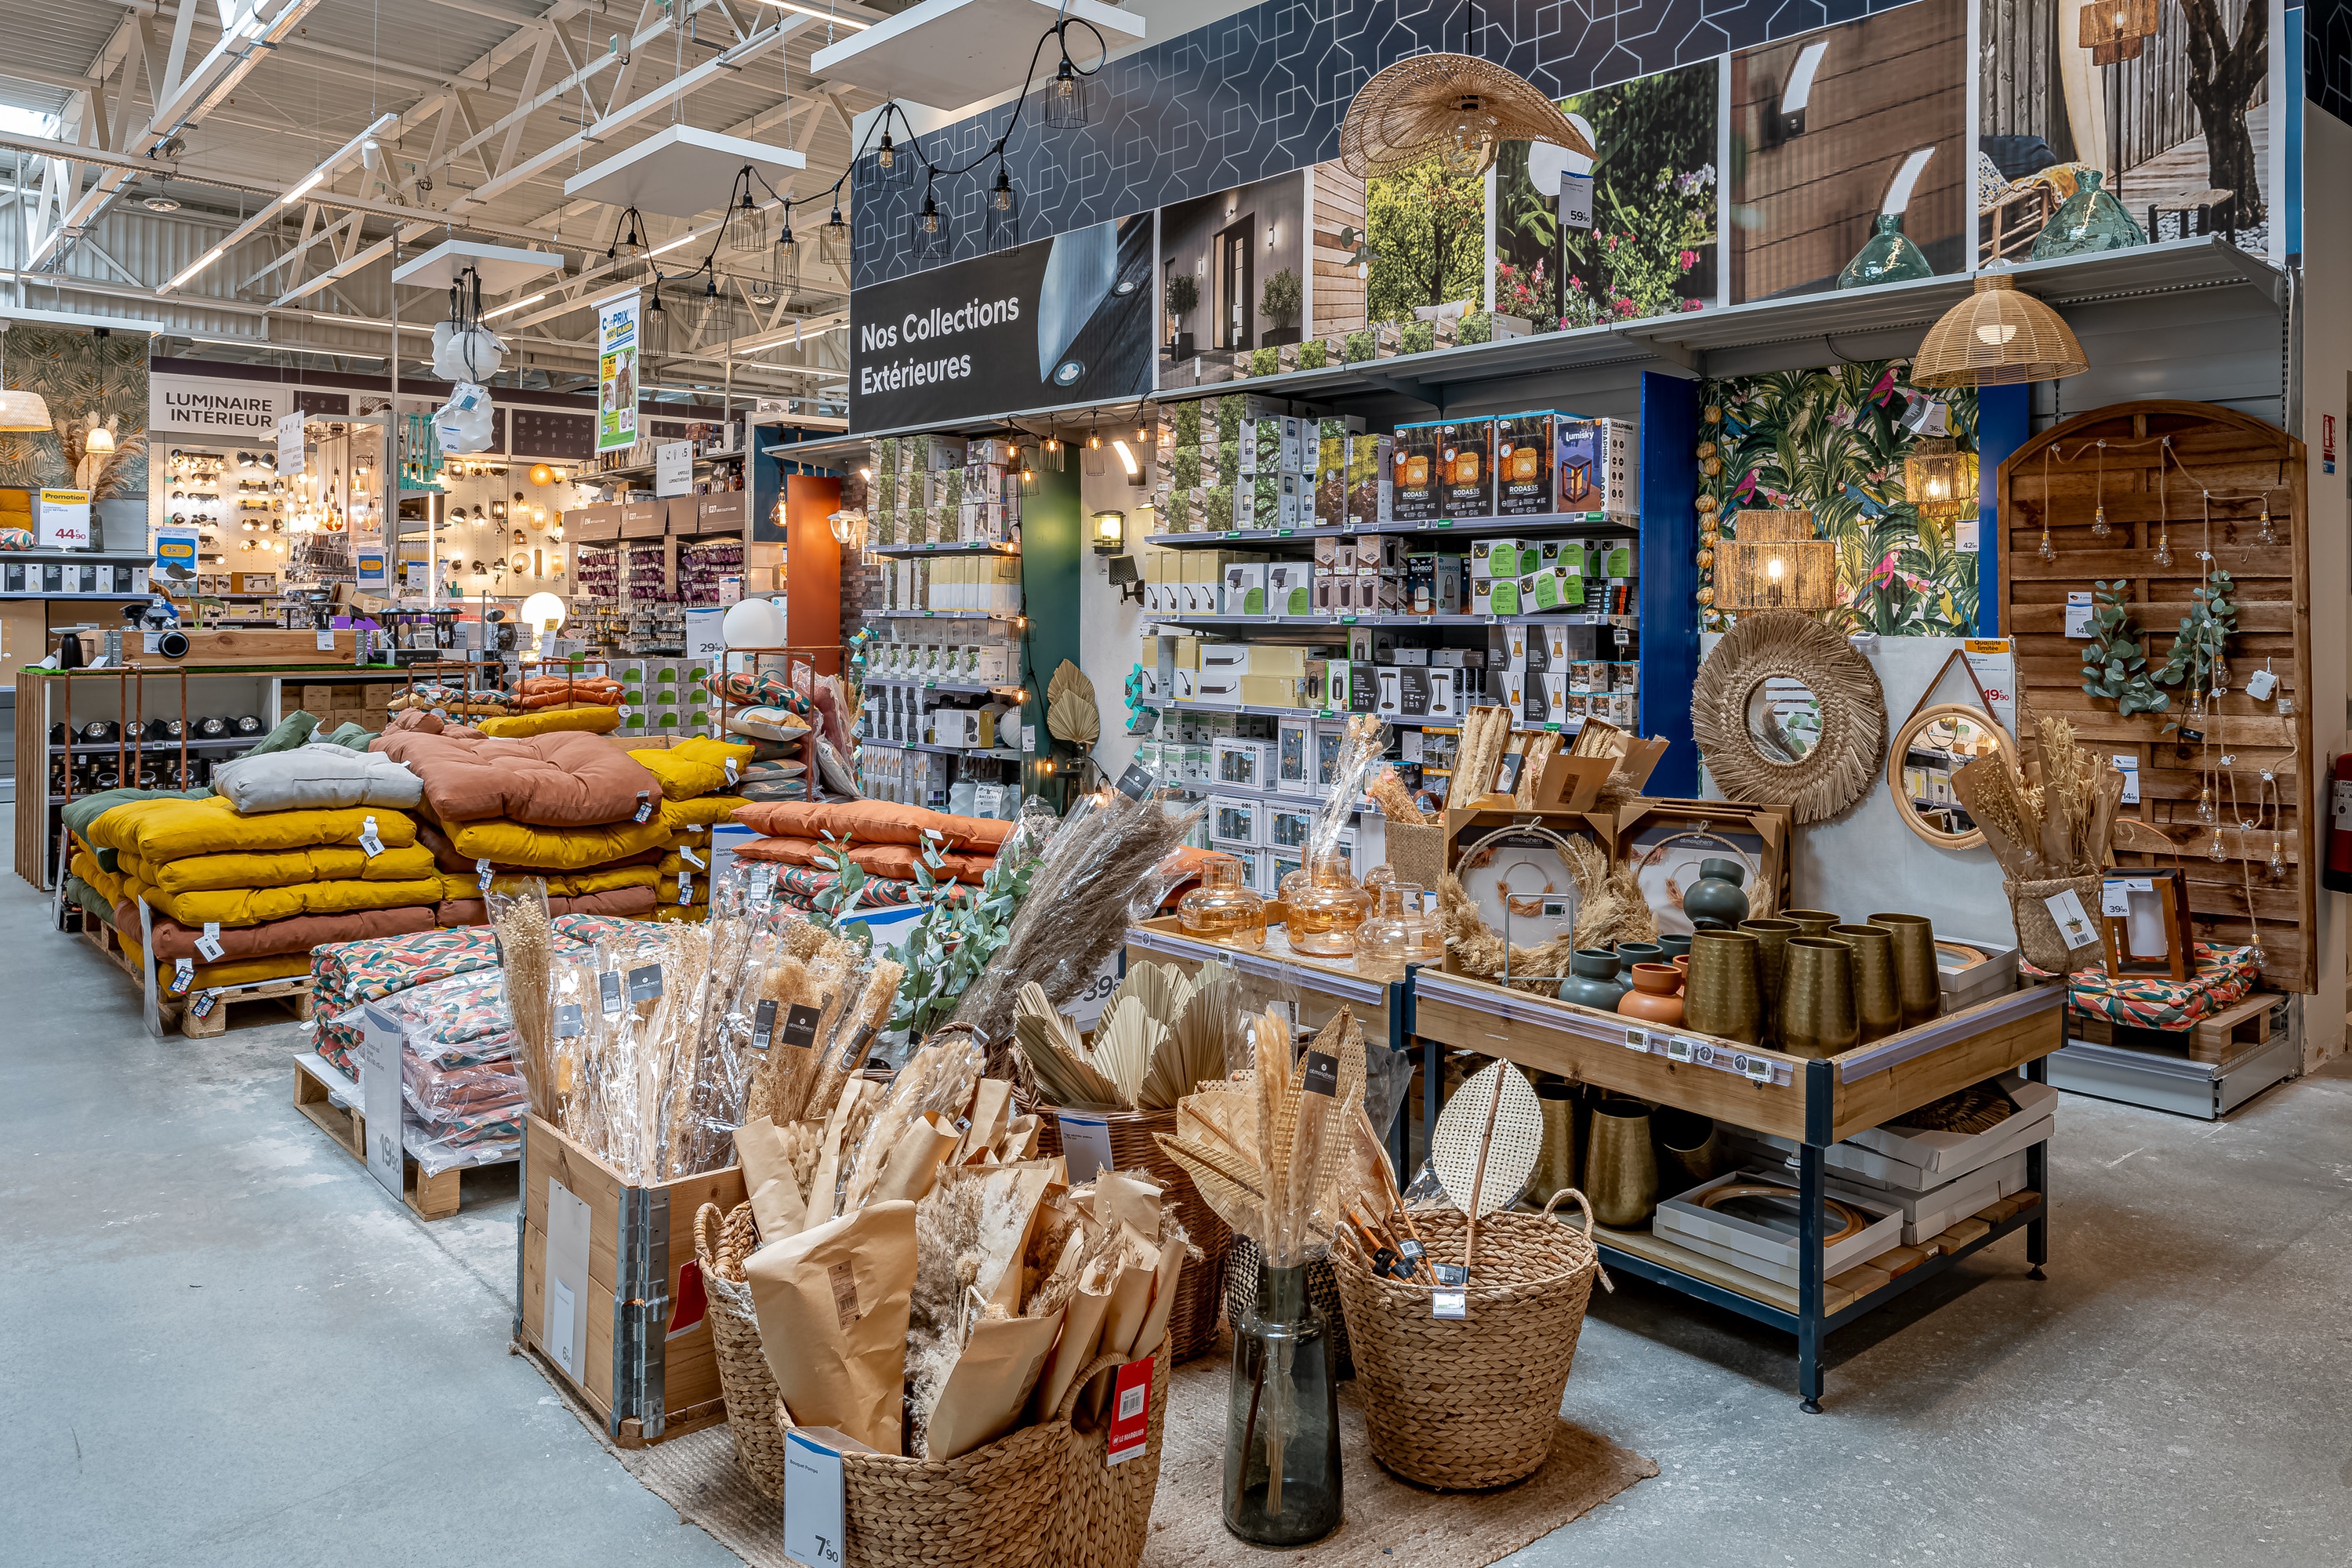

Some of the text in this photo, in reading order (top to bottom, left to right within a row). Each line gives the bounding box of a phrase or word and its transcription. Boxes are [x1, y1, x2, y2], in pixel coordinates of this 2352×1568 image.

[613, 309, 629, 327] PRIX
[618, 322, 633, 336] PLAISIR
[861, 296, 1020, 353] Nos Collections
[861, 353, 972, 396] Extérieures
[165, 391, 273, 412] LUMINAIRE
[171, 407, 273, 428] INTÉRIEUR
[1610, 422, 1634, 431] SERAPHINA
[684, 448, 688, 458] 5
[668, 476, 690, 485] LUMINOTHÉRAPIE
[1509, 485, 1538, 493] RODAS35
[709, 505, 717, 514] E27
[55, 528, 86, 539] 44€90
[699, 643, 724, 652] 29€90
[1984, 689, 2009, 701] 19€90
[1124, 775, 1145, 790] atmosphera
[1508, 837, 1544, 845] atmosphera
[1679, 837, 1714, 846] atmosphera
[2109, 905, 2128, 913] 39€90
[632, 980, 659, 990] atmosphera
[788, 1022, 815, 1033] atmosphera
[1309, 1069, 1336, 1080] atmosphera
[379, 1133, 400, 1174] 19€90
[562, 1345, 572, 1366] 6€90
[1124, 1428, 1145, 1442] MARQUIER
[789, 1459, 818, 1475] Bouquet Pampa
[815, 1534, 839, 1563] 7€90
